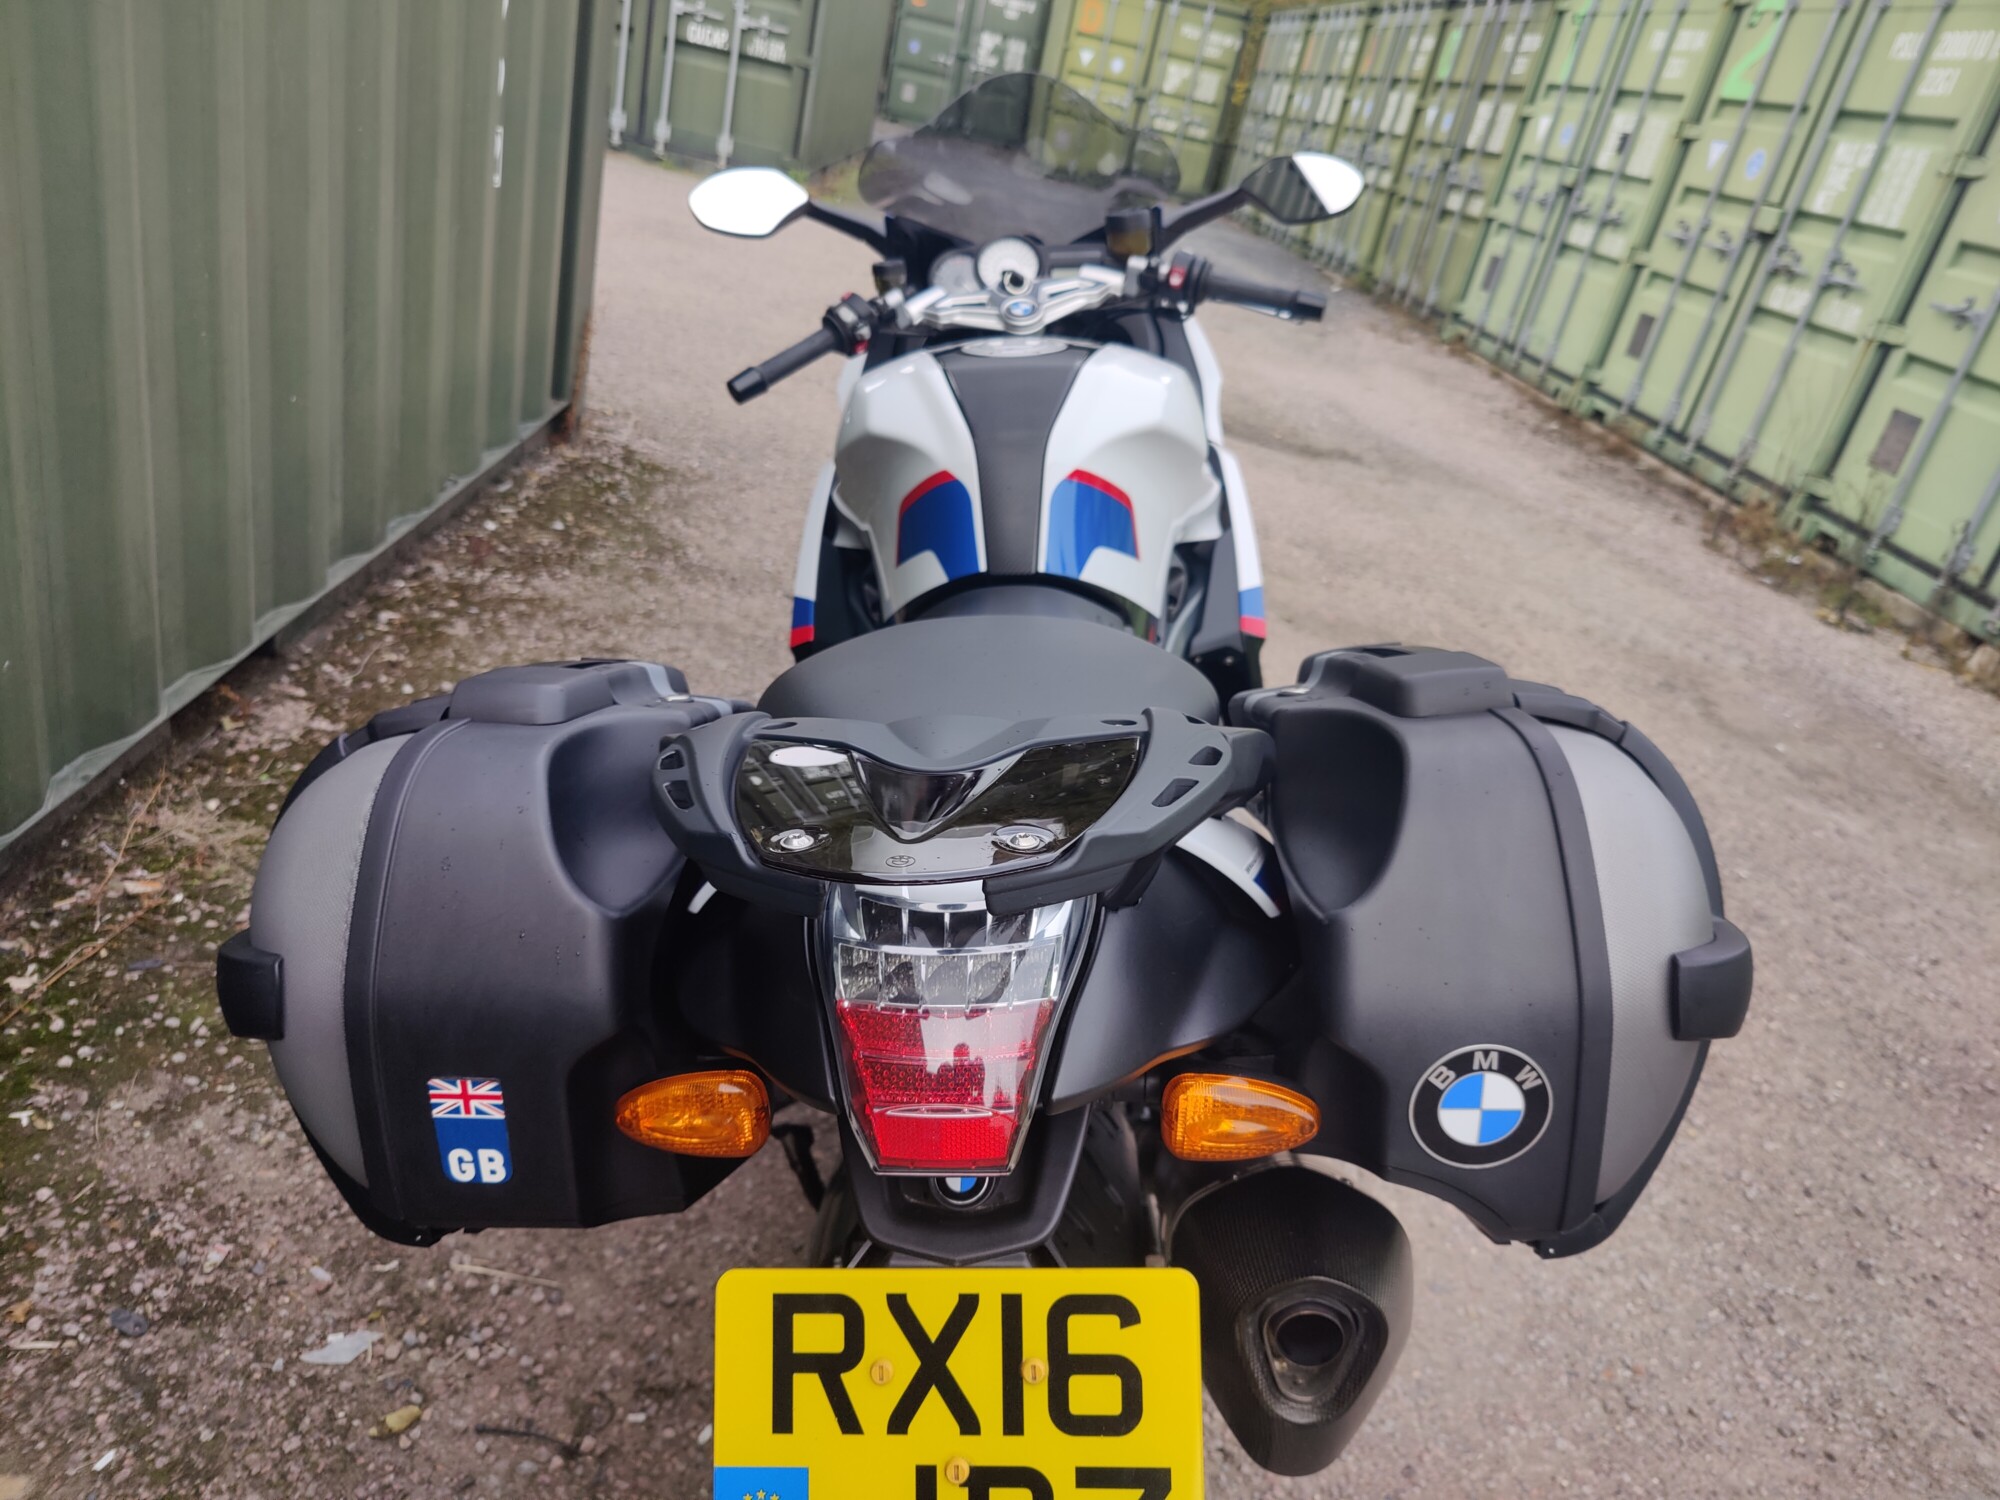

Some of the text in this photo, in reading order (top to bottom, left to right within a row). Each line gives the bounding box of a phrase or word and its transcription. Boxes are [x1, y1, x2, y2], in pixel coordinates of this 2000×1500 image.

[1428, 1050, 1543, 1091] BMW
[447, 1147, 507, 1184] GB
[772, 1293, 1144, 1438] RX16
